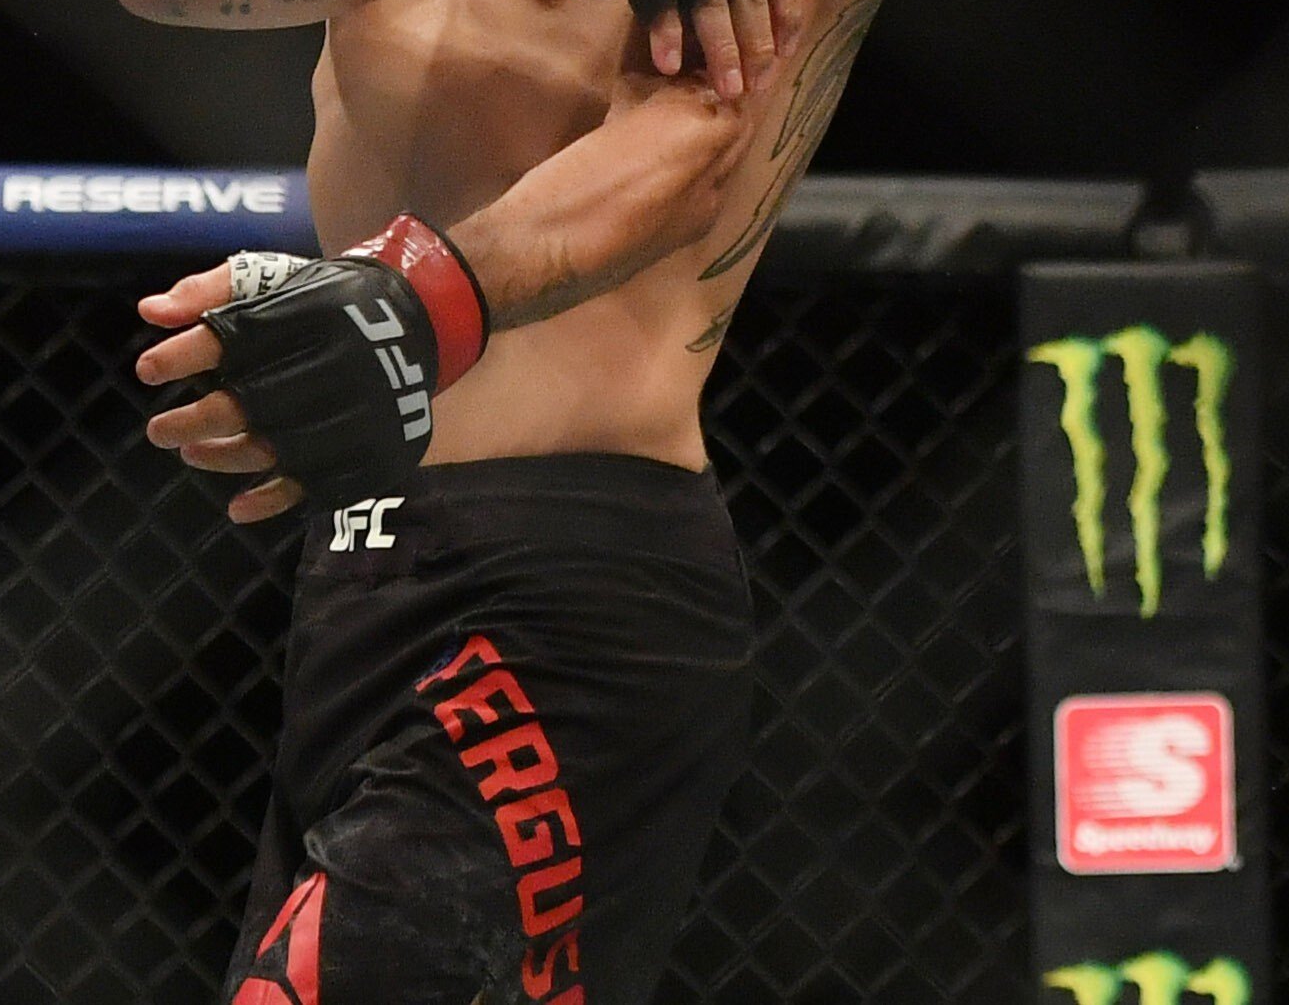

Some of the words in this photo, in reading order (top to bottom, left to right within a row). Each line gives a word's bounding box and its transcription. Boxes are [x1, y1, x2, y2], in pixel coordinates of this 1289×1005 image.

[2, 175, 286, 213] RESERVE
[343, 298, 432, 442] UFC
[329, 496, 406, 552] UFC
